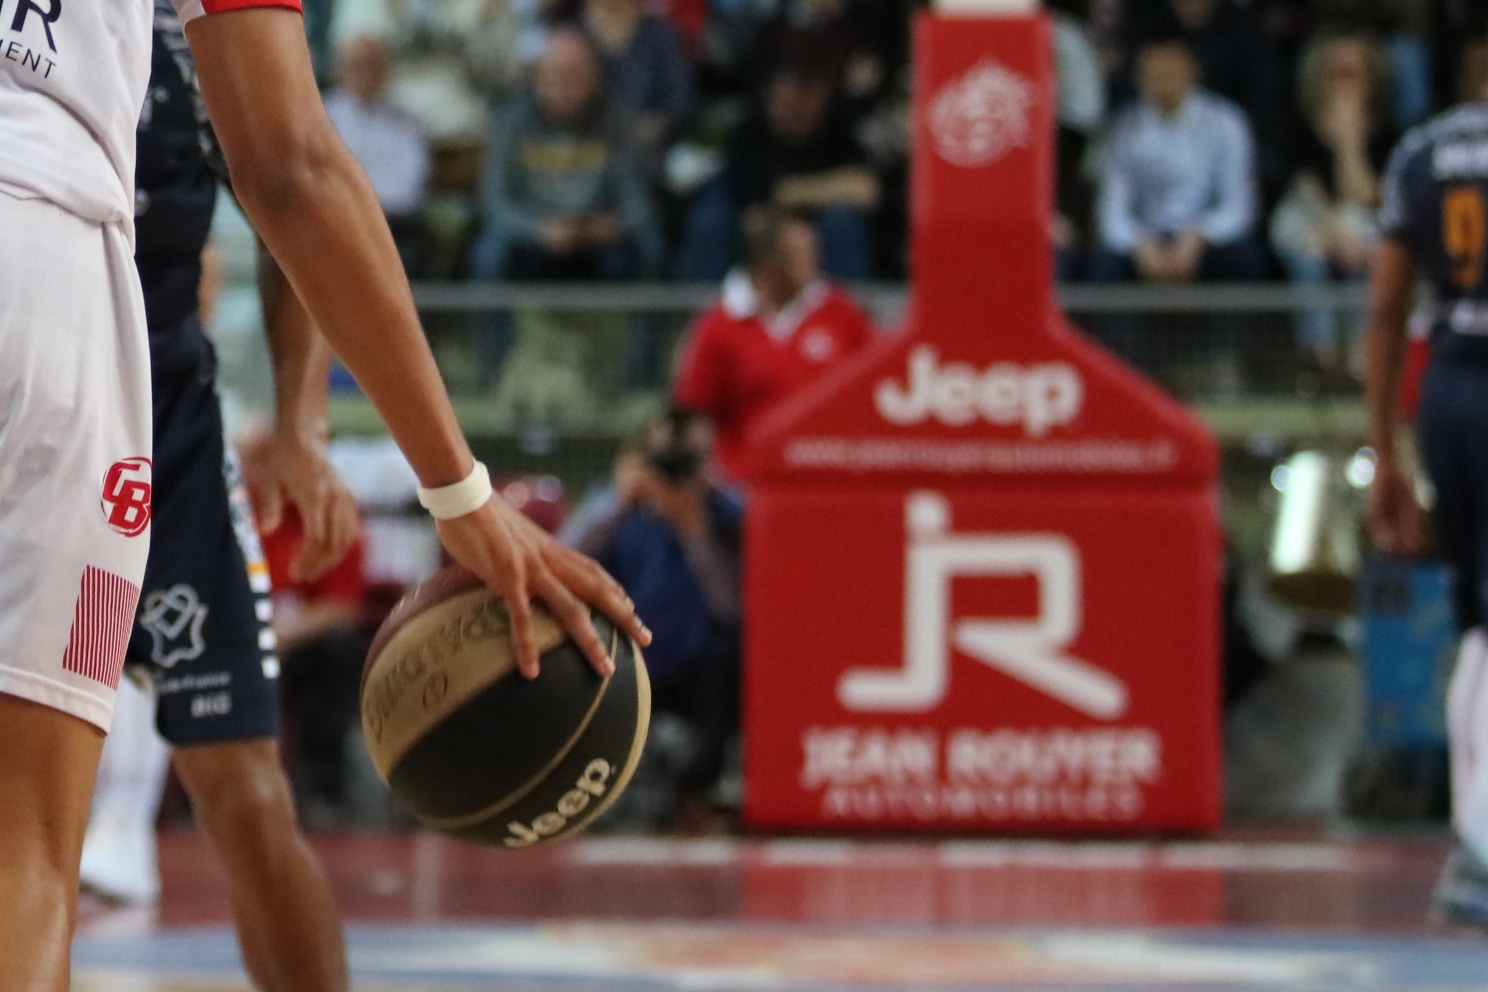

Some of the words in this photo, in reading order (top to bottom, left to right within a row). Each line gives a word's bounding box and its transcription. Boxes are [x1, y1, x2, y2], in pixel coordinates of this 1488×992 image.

[875, 346, 1084, 436] Jeep
[802, 728, 939, 787] JEAN
[947, 728, 1161, 785] ROUYER
[503, 758, 610, 848] Jeep
[824, 787, 1142, 820] AUTOMOBILES
